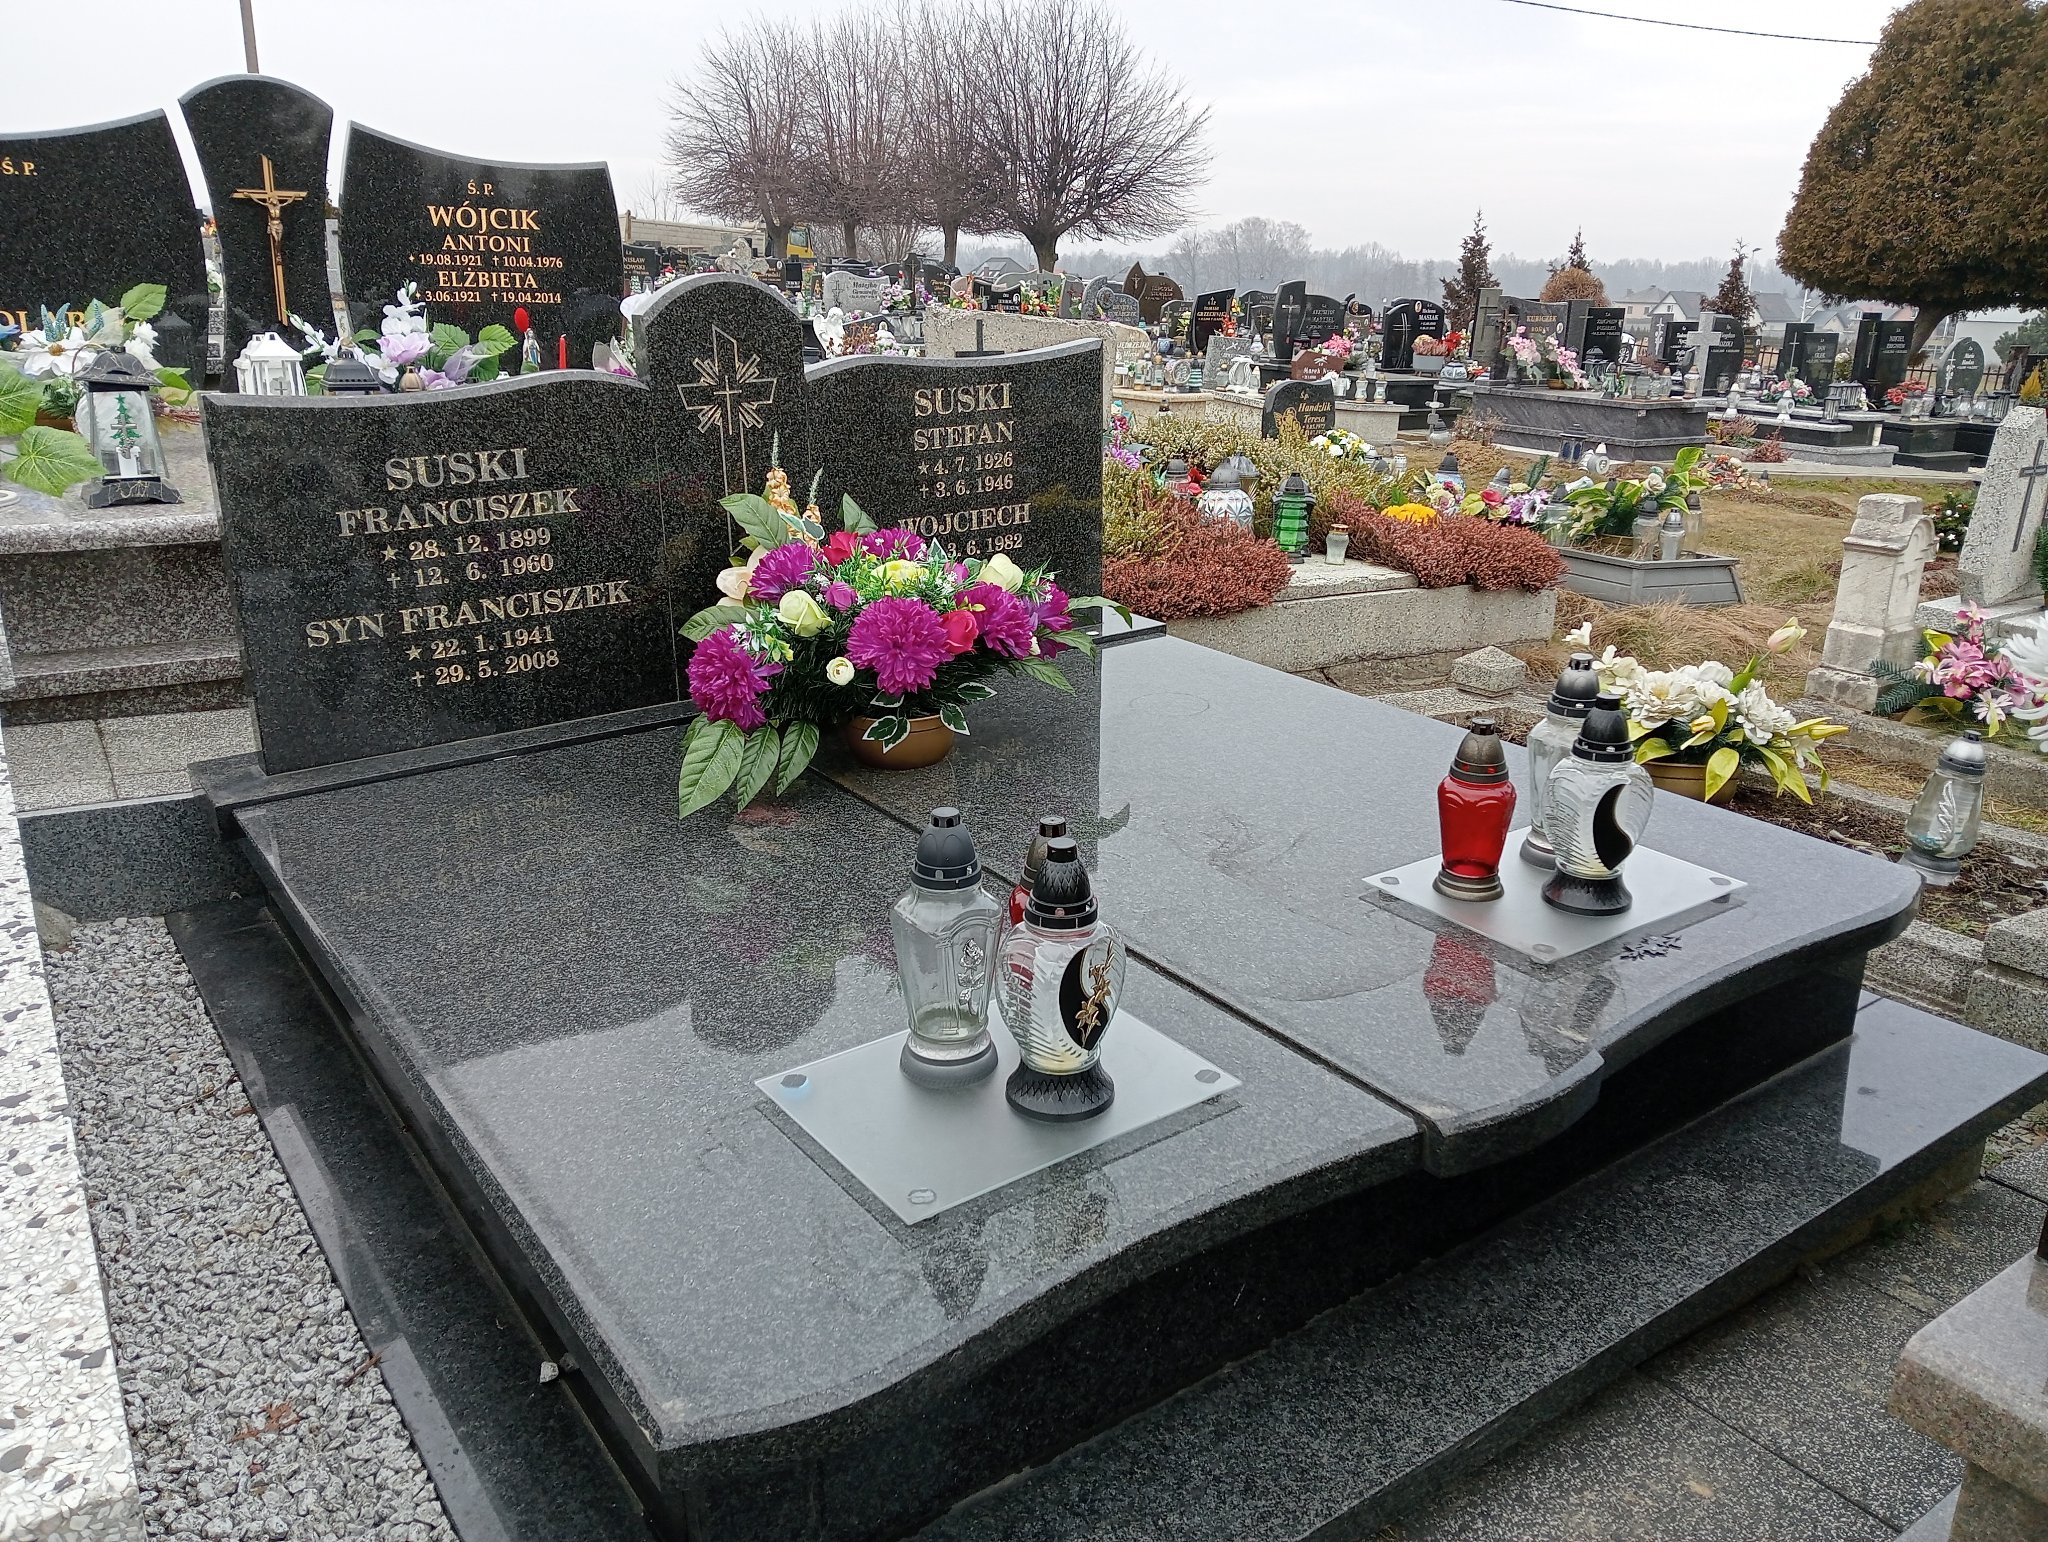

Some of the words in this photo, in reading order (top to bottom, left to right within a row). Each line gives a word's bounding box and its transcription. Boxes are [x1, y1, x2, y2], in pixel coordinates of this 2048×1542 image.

[427, 200, 540, 233] WÓJCIK
[442, 234, 530, 253] ANTONI
[419, 254, 482, 266] 19.08.1921
[503, 256, 563, 268] 10.04.1976
[437, 267, 539, 289] ELŻBIETA
[425, 291, 481, 302] 3.06.1921
[501, 291, 562, 304] 19.04.2014
[915, 382, 1013, 417] SUSKI
[1304, 415, 1326, 423] Teresa
[914, 421, 1014, 451] STEFAN
[384, 448, 530, 491] SUSKI
[976, 451, 1013, 470] 1926
[936, 482, 951, 498] 3.
[956, 480, 970, 495] 6.
[976, 473, 1014, 493] 1946
[336, 488, 581, 537] FRANCISZEK
[898, 502, 1032, 537] WOJCIECH
[409, 539, 446, 561] 28.
[455, 534, 489, 555] 12.
[497, 527, 551, 550] 1899
[986, 533, 1023, 553] 1982
[414, 566, 450, 588] 12.
[466, 561, 487, 581] 6.
[500, 553, 554, 577] 1960
[305, 614, 385, 648] SYN
[399, 580, 632, 634] FRANCISZEK
[431, 639, 467, 659] 22.
[475, 634, 494, 652] 1.
[503, 625, 555, 648] 1941
[435, 664, 471, 685] 29.
[478, 659, 498, 679] 5.
[505, 650, 560, 674] 2008
